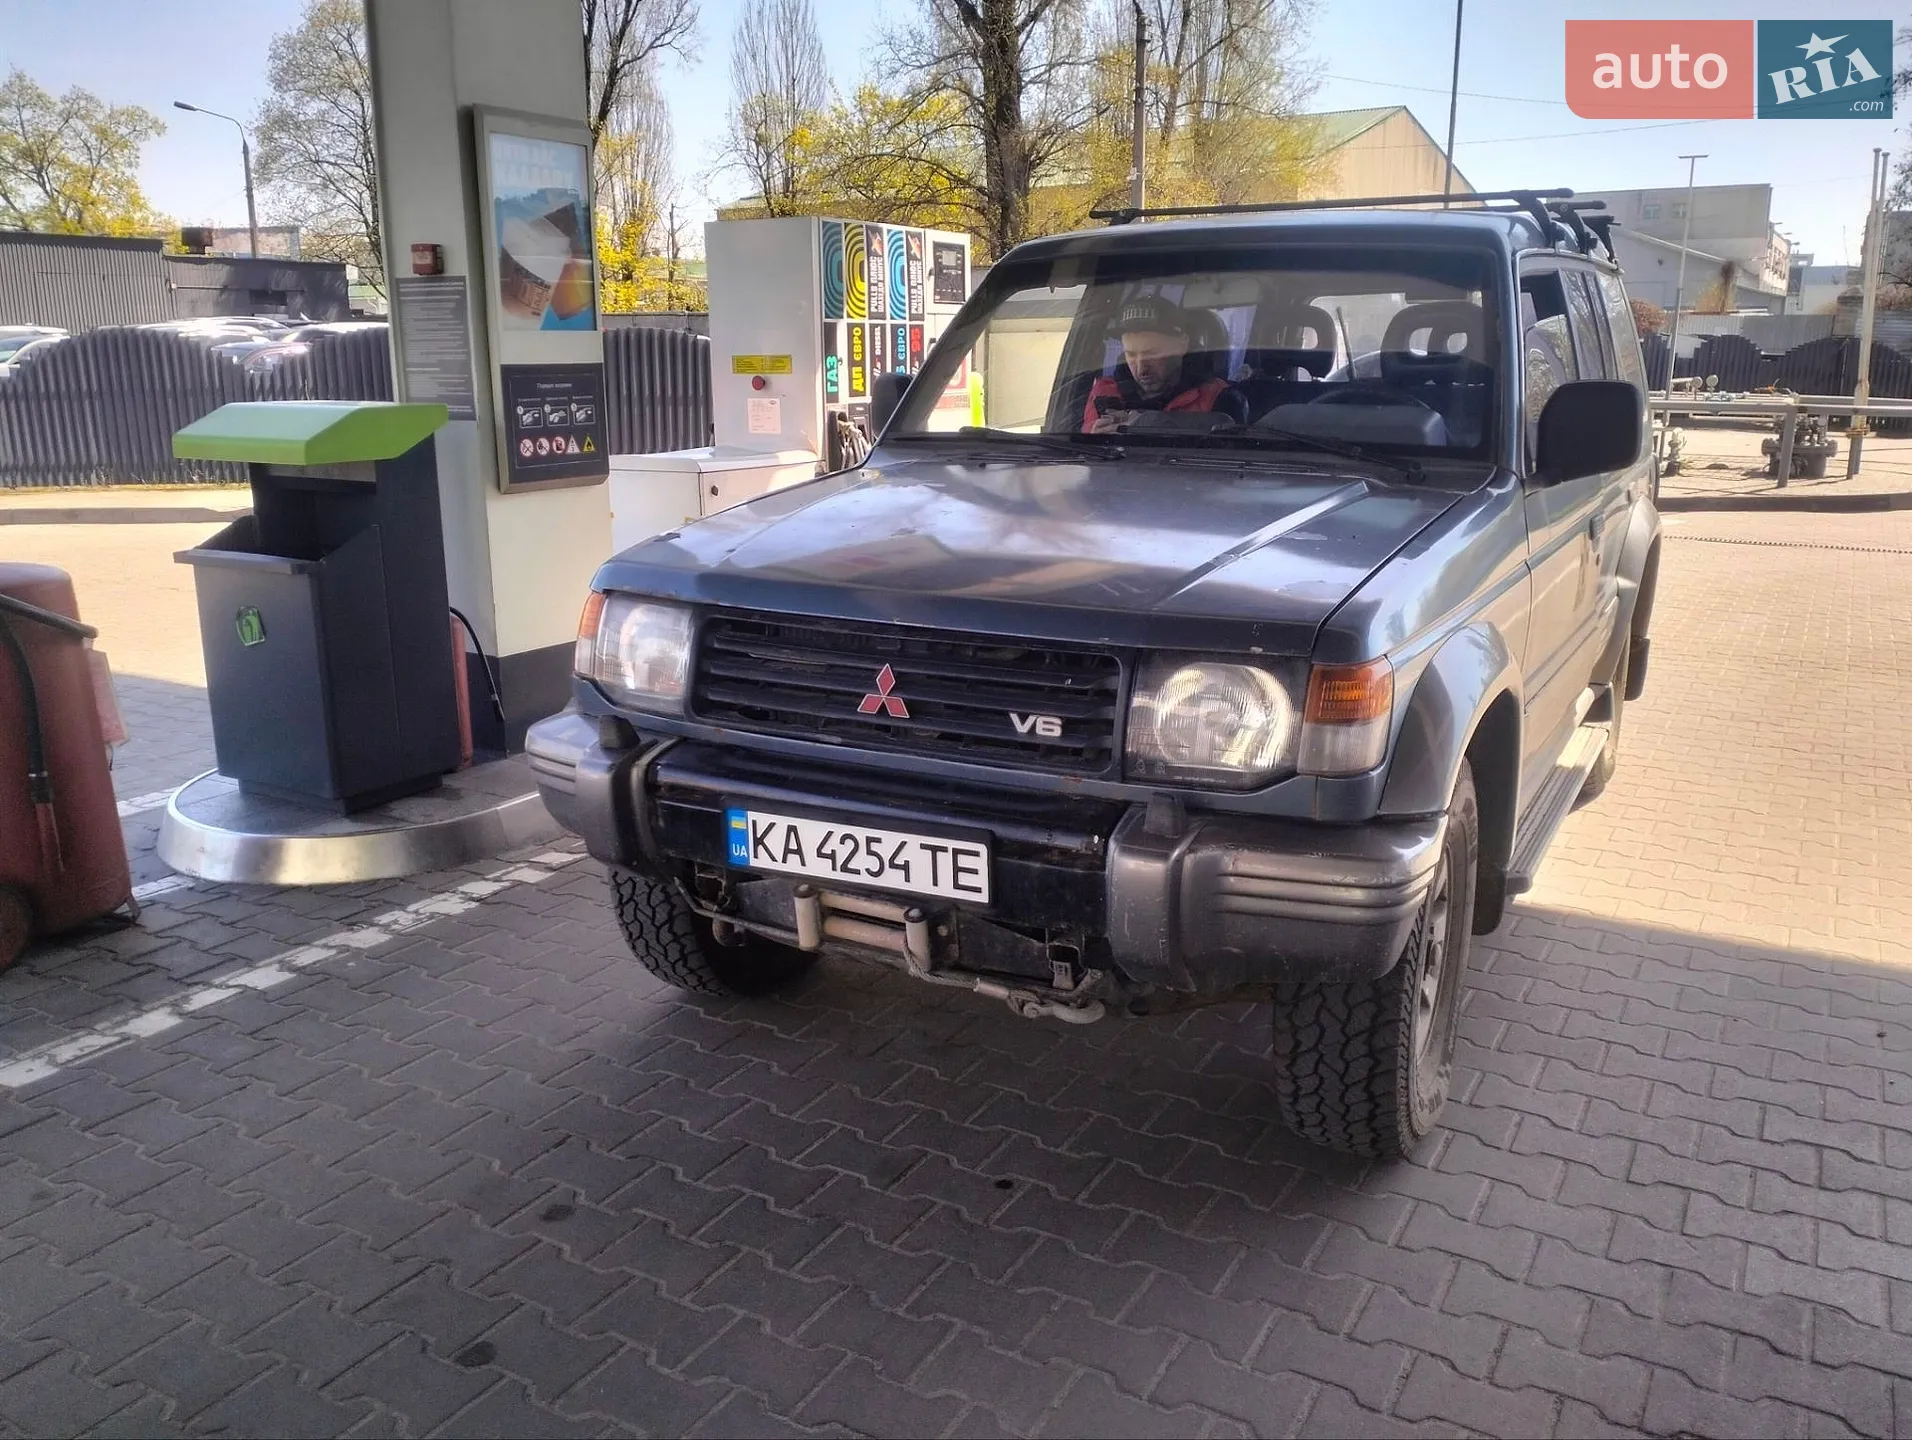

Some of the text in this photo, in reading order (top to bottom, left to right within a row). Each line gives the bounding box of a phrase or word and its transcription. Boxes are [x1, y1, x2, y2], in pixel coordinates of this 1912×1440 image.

[874, 326, 882, 355] DIESEL
[826, 355, 838, 393] ГАЗ
[852, 366, 864, 392] ДП
[1008, 711, 1063, 738] V6
[732, 843, 748, 858] UA
[751, 818, 983, 894] KA 4254 TE
